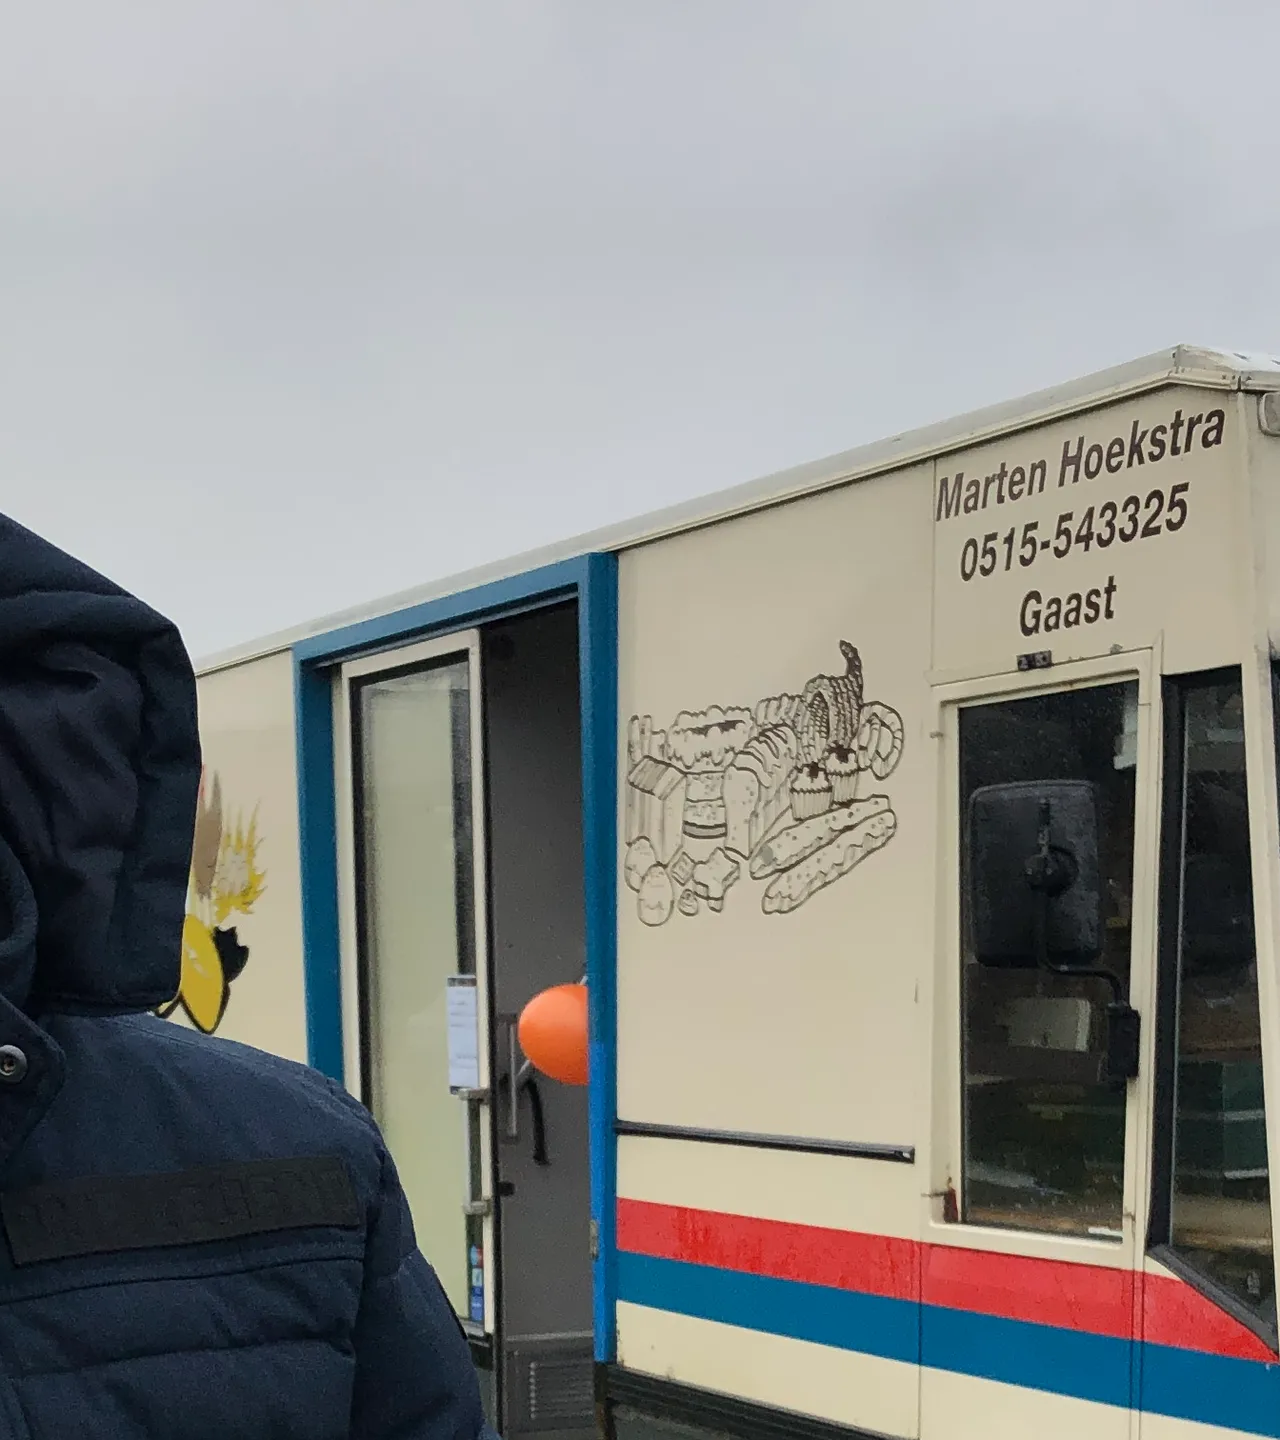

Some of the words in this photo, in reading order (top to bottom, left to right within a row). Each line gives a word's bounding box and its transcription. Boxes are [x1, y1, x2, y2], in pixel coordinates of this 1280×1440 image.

[935, 458, 1047, 522] Marten
[1058, 407, 1227, 488] Hoekstra
[960, 482, 1191, 582] 0515-543325
[1019, 575, 1118, 637] Gaast
